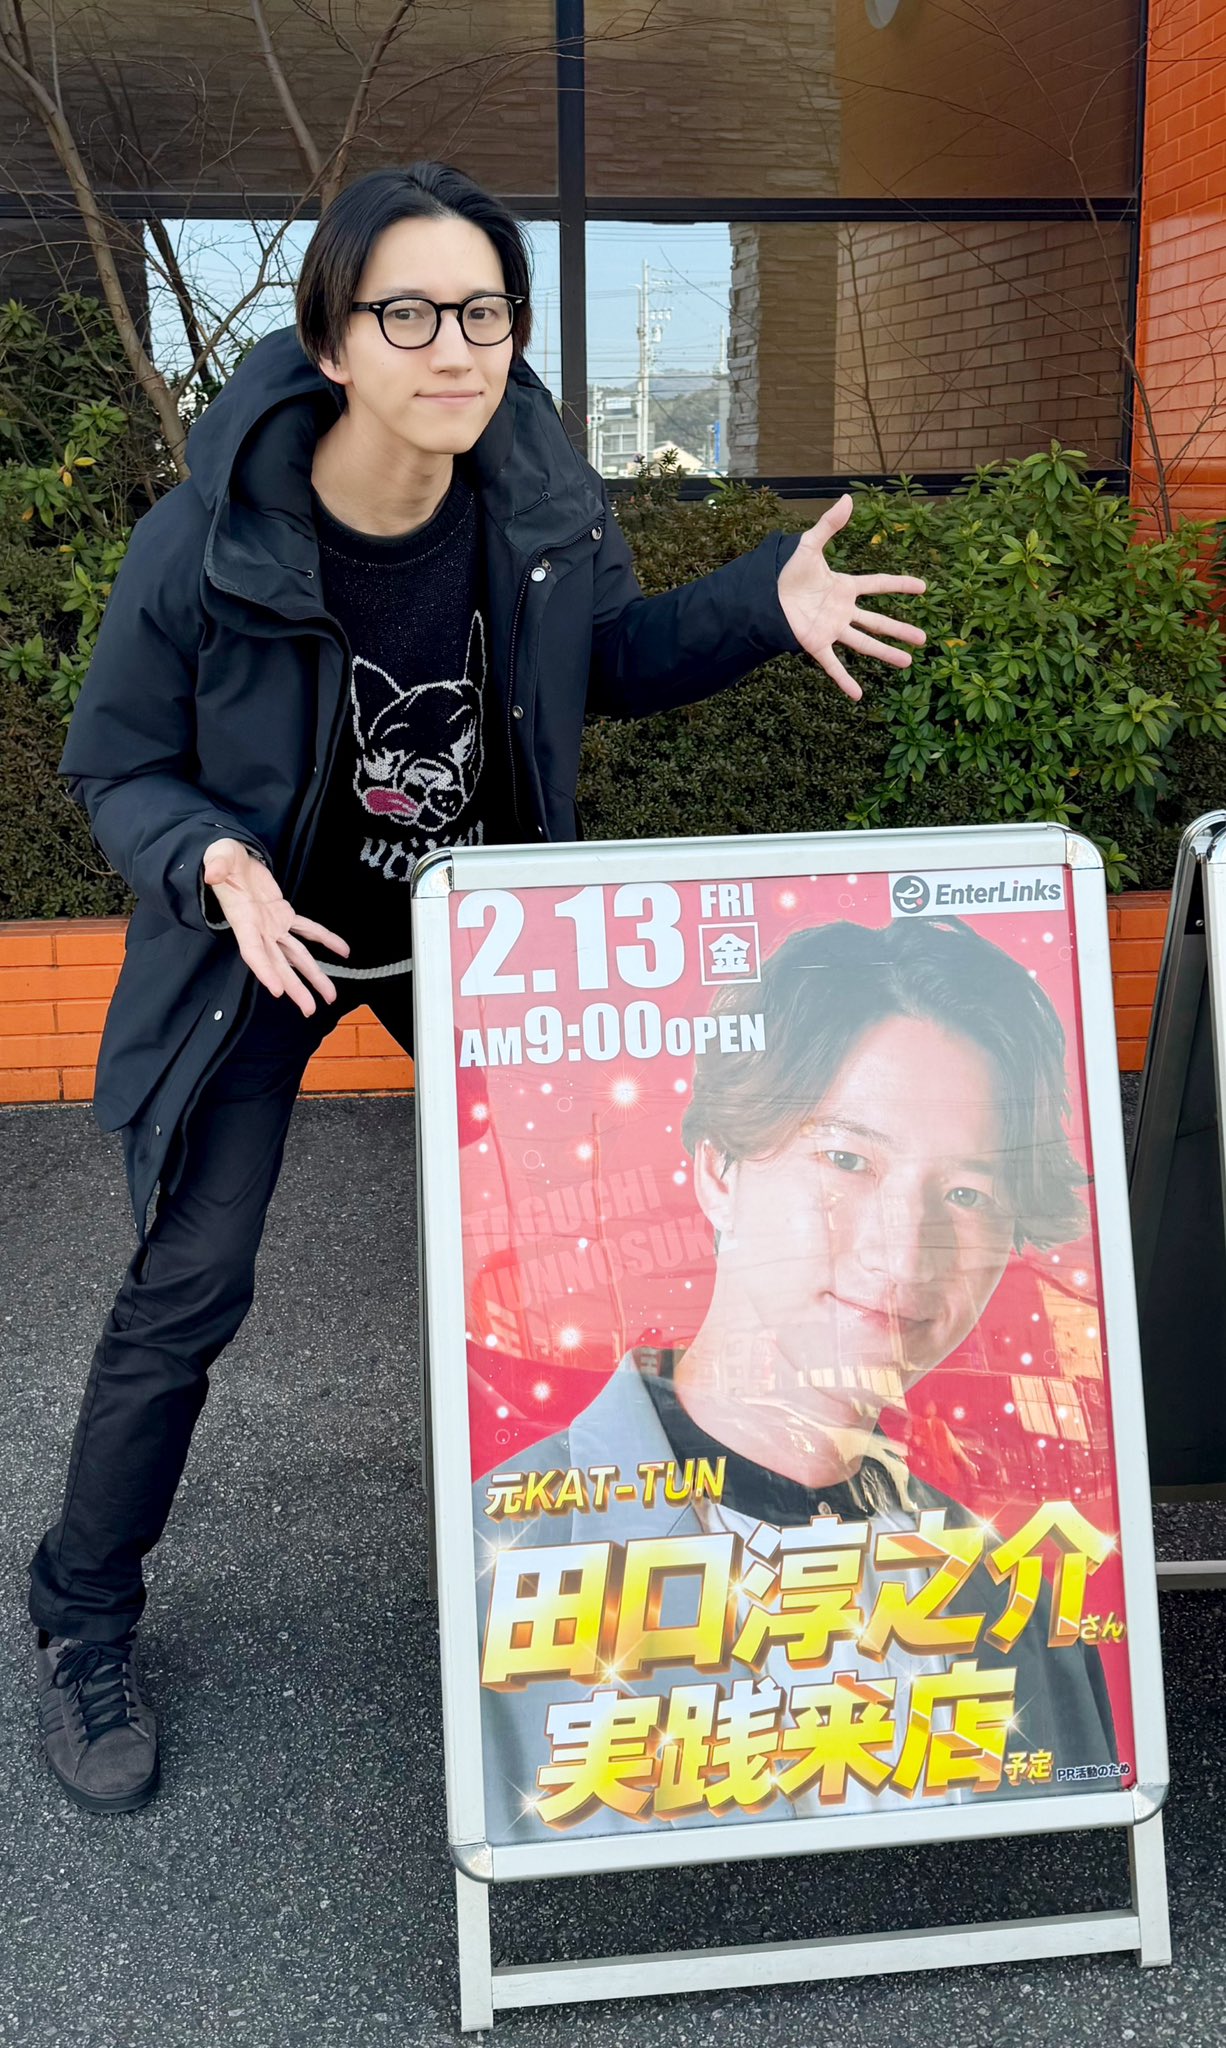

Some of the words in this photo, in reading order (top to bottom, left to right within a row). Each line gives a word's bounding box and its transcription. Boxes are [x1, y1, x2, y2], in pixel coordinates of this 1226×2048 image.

[699, 882, 755, 918] FRI
[935, 878, 1062, 906] EnterLinks
[456, 881, 686, 997] 2.13
[707, 932, 751, 974] 金
[483, 1455, 728, 1523] 元KAT-TUN
[1056, 1761, 1132, 1782] PR活動のため
